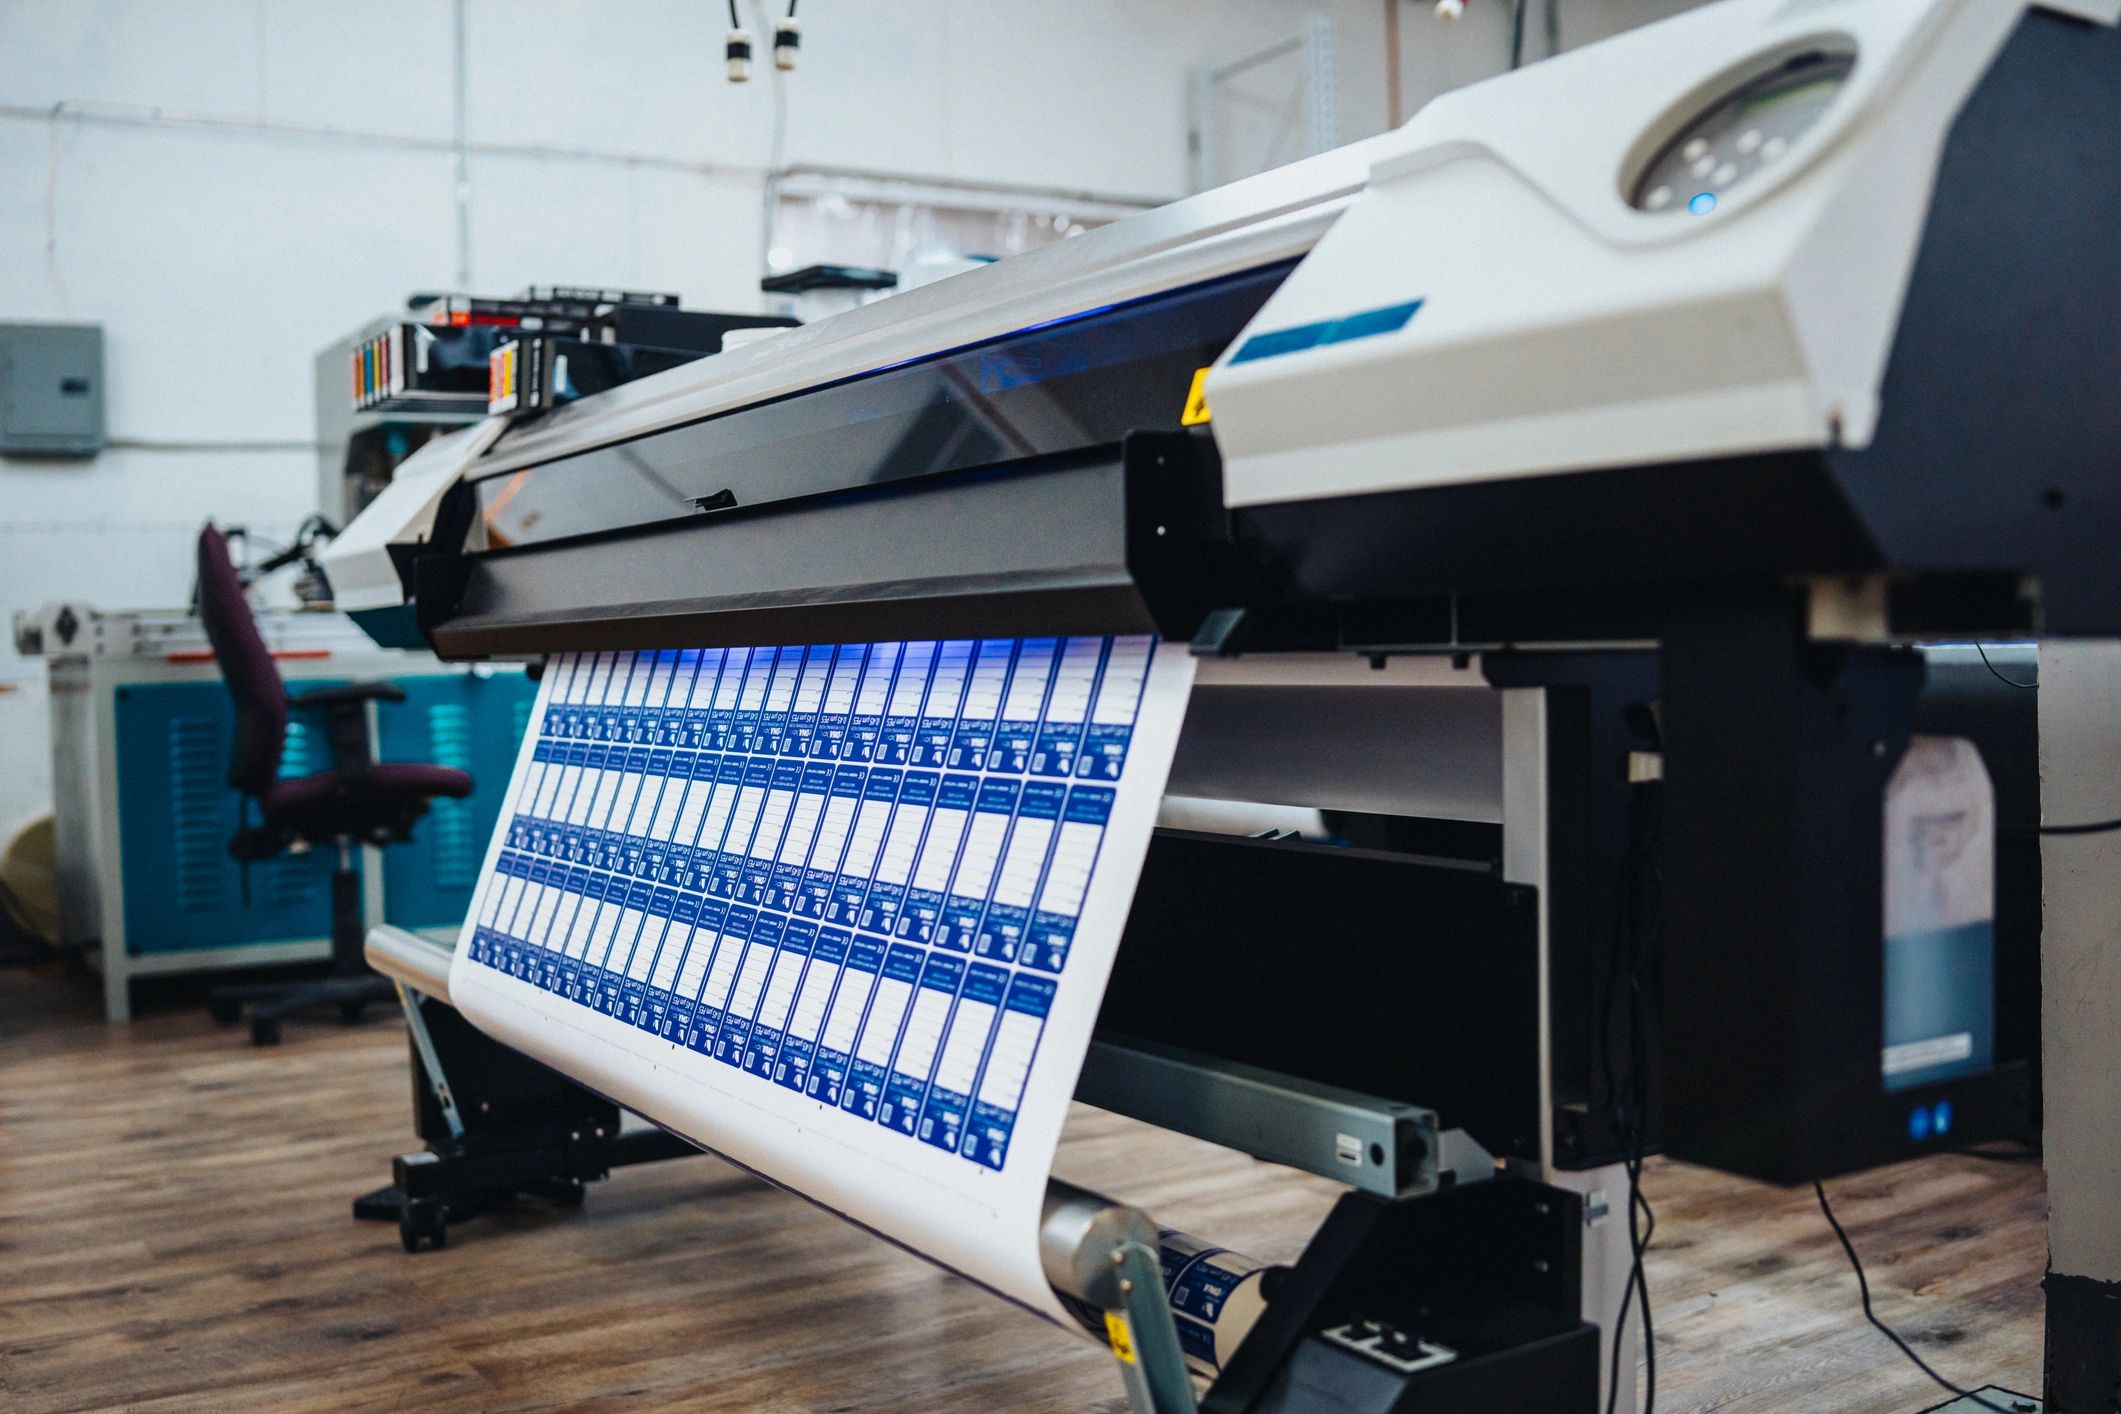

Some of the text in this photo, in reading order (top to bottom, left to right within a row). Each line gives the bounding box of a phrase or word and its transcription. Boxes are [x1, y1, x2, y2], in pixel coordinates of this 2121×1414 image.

[763, 713, 771, 721] PES
[791, 714, 799, 722] PES
[821, 715, 830, 723] PES
[853, 717, 862, 725] PES
[694, 849, 702, 857] PES
[720, 854, 728, 863] PES
[747, 859, 756, 868] PES
[776, 865, 786, 873] PES
[806, 870, 816, 879] PES
[672, 996, 680, 1005] PES
[698, 1005, 707, 1015] PES
[725, 1015, 734, 1025] PES
[755, 1025, 764, 1035] PES
